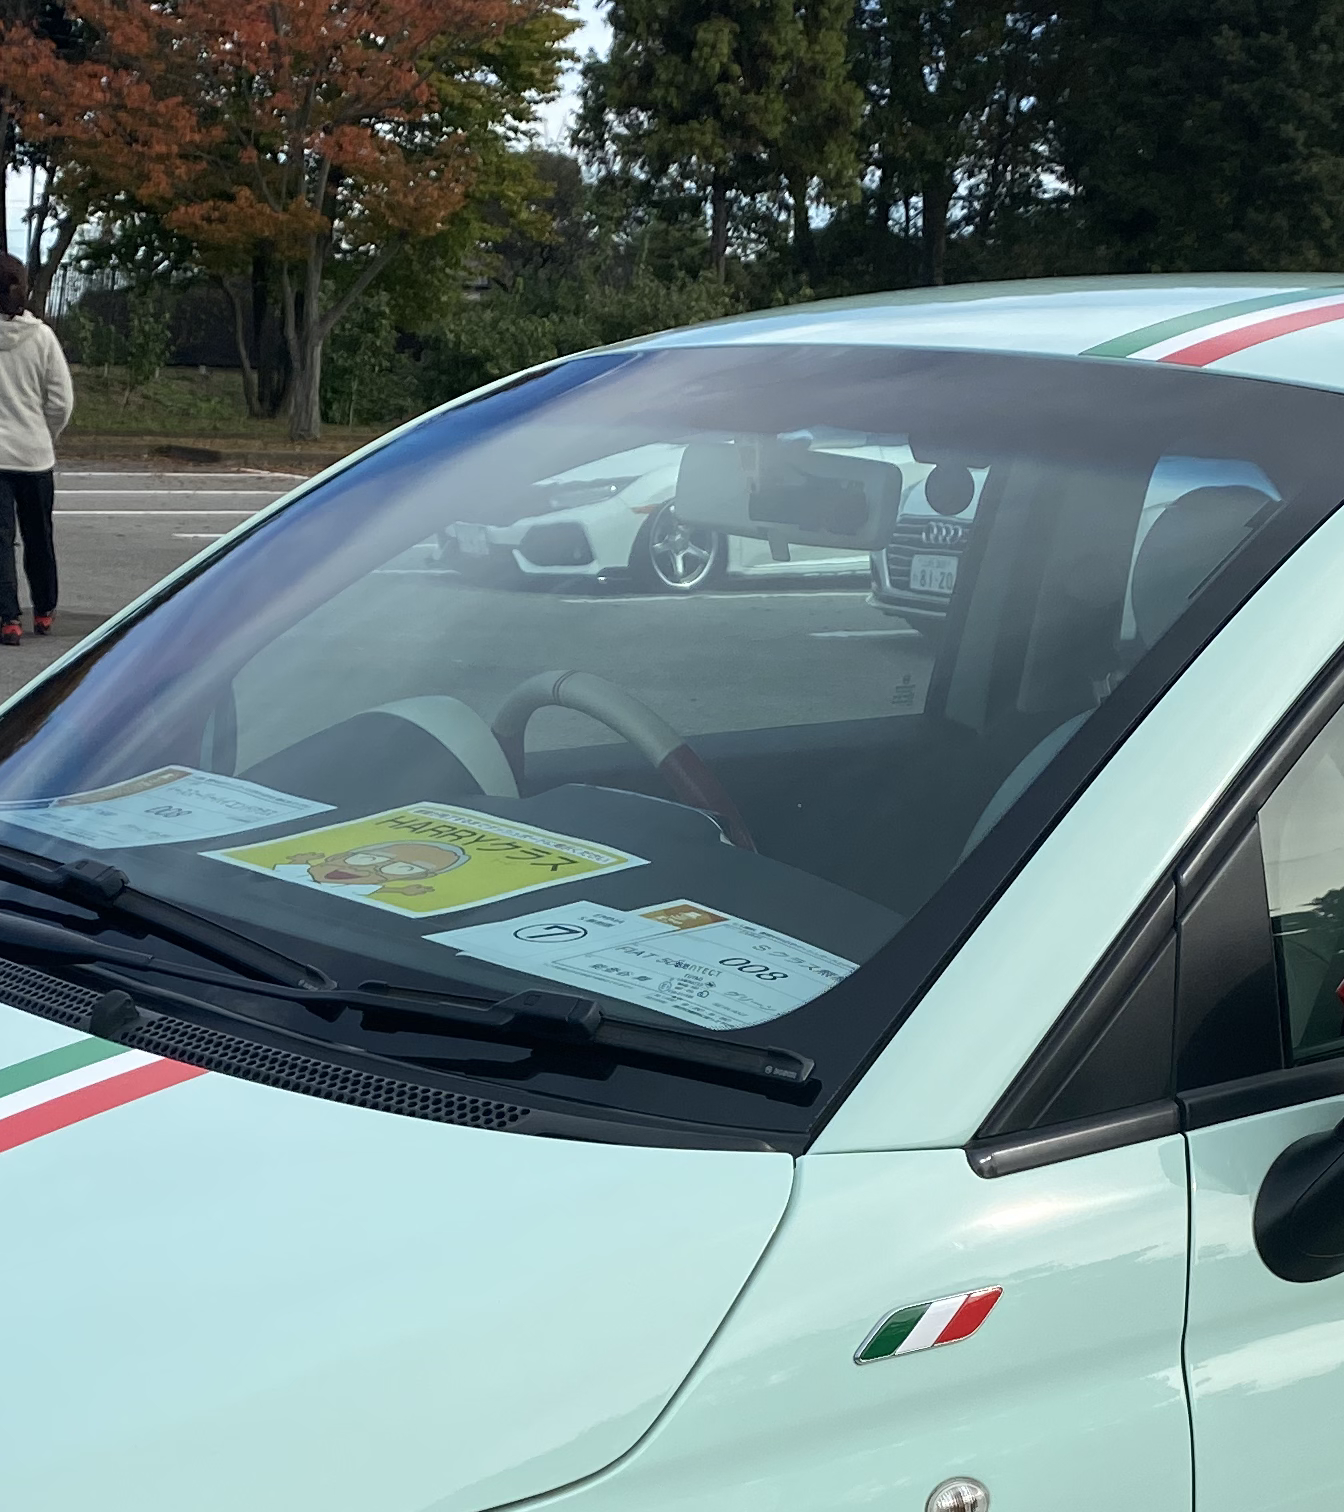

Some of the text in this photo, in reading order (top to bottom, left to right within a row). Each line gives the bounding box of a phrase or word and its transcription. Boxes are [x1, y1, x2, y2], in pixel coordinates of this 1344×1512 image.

[374, 814, 581, 873] HARRYクラス
[718, 957, 789, 981] 008
